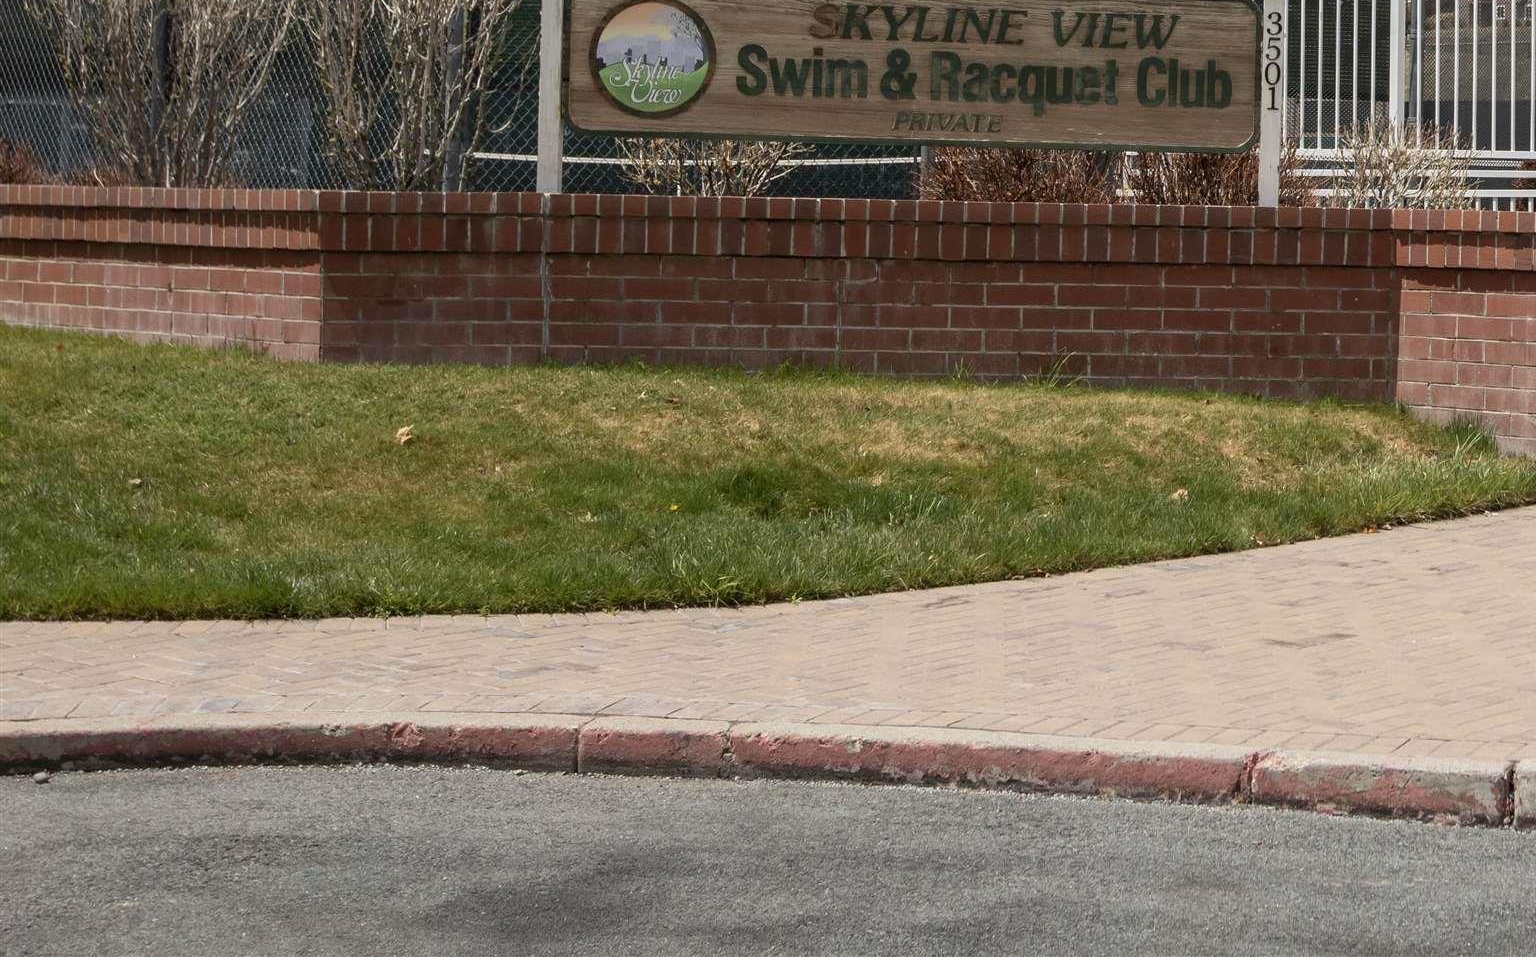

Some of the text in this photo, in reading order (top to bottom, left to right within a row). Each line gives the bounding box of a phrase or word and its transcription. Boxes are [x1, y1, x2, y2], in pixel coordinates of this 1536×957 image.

[808, 3, 1180, 49] SKYLINE VIEW
[609, 55, 680, 87] Skyline
[736, 44, 1233, 117] Swim & Racquet Club
[1265, 12, 1282, 110] 3501
[631, 80, 682, 103] View
[890, 111, 1003, 133] PRIVATE
